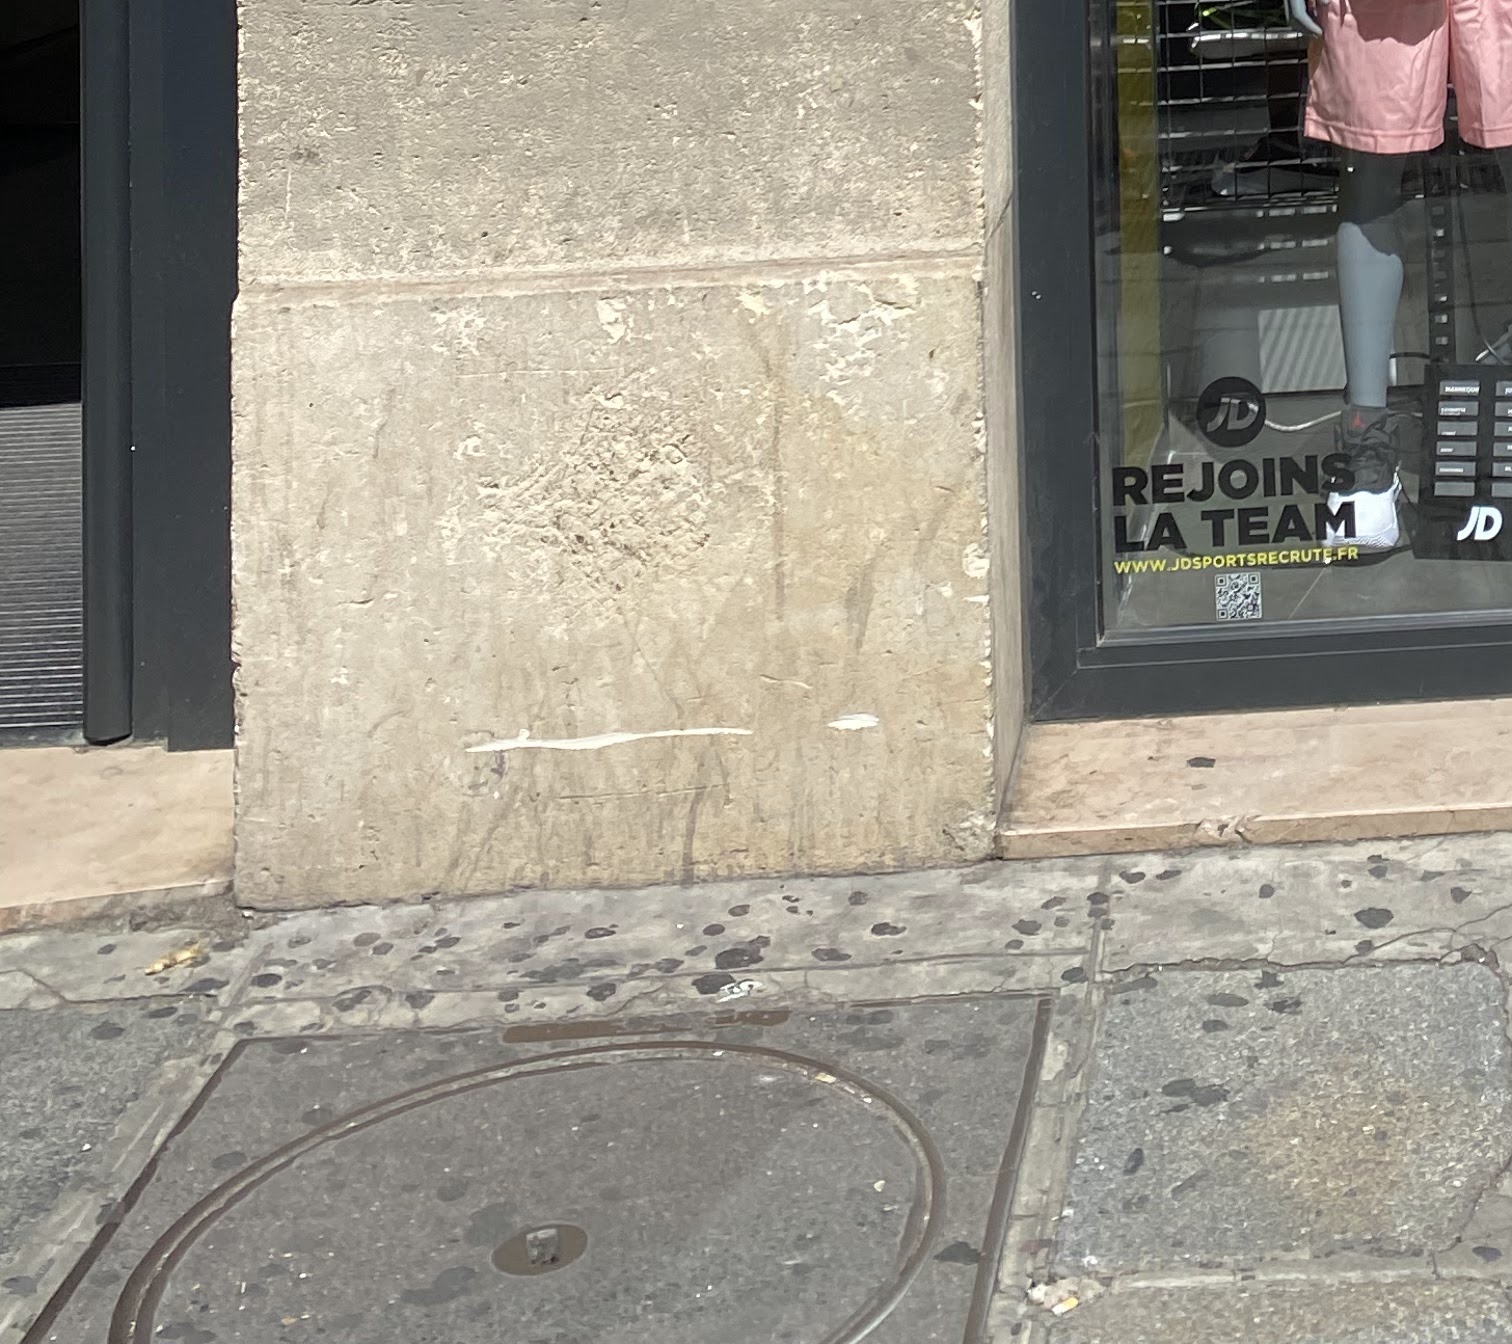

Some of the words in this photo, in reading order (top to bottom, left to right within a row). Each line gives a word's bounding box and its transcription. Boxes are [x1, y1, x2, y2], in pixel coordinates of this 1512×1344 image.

[1206, 397, 1259, 433] JD
[1112, 453, 1355, 507] REJOINS
[1114, 512, 1187, 553] LA
[1201, 500, 1356, 548] TEAM
[1456, 506, 1503, 541] JD
[1114, 546, 1359, 574] WWW.JDSPORTSRECRUTE.FR
